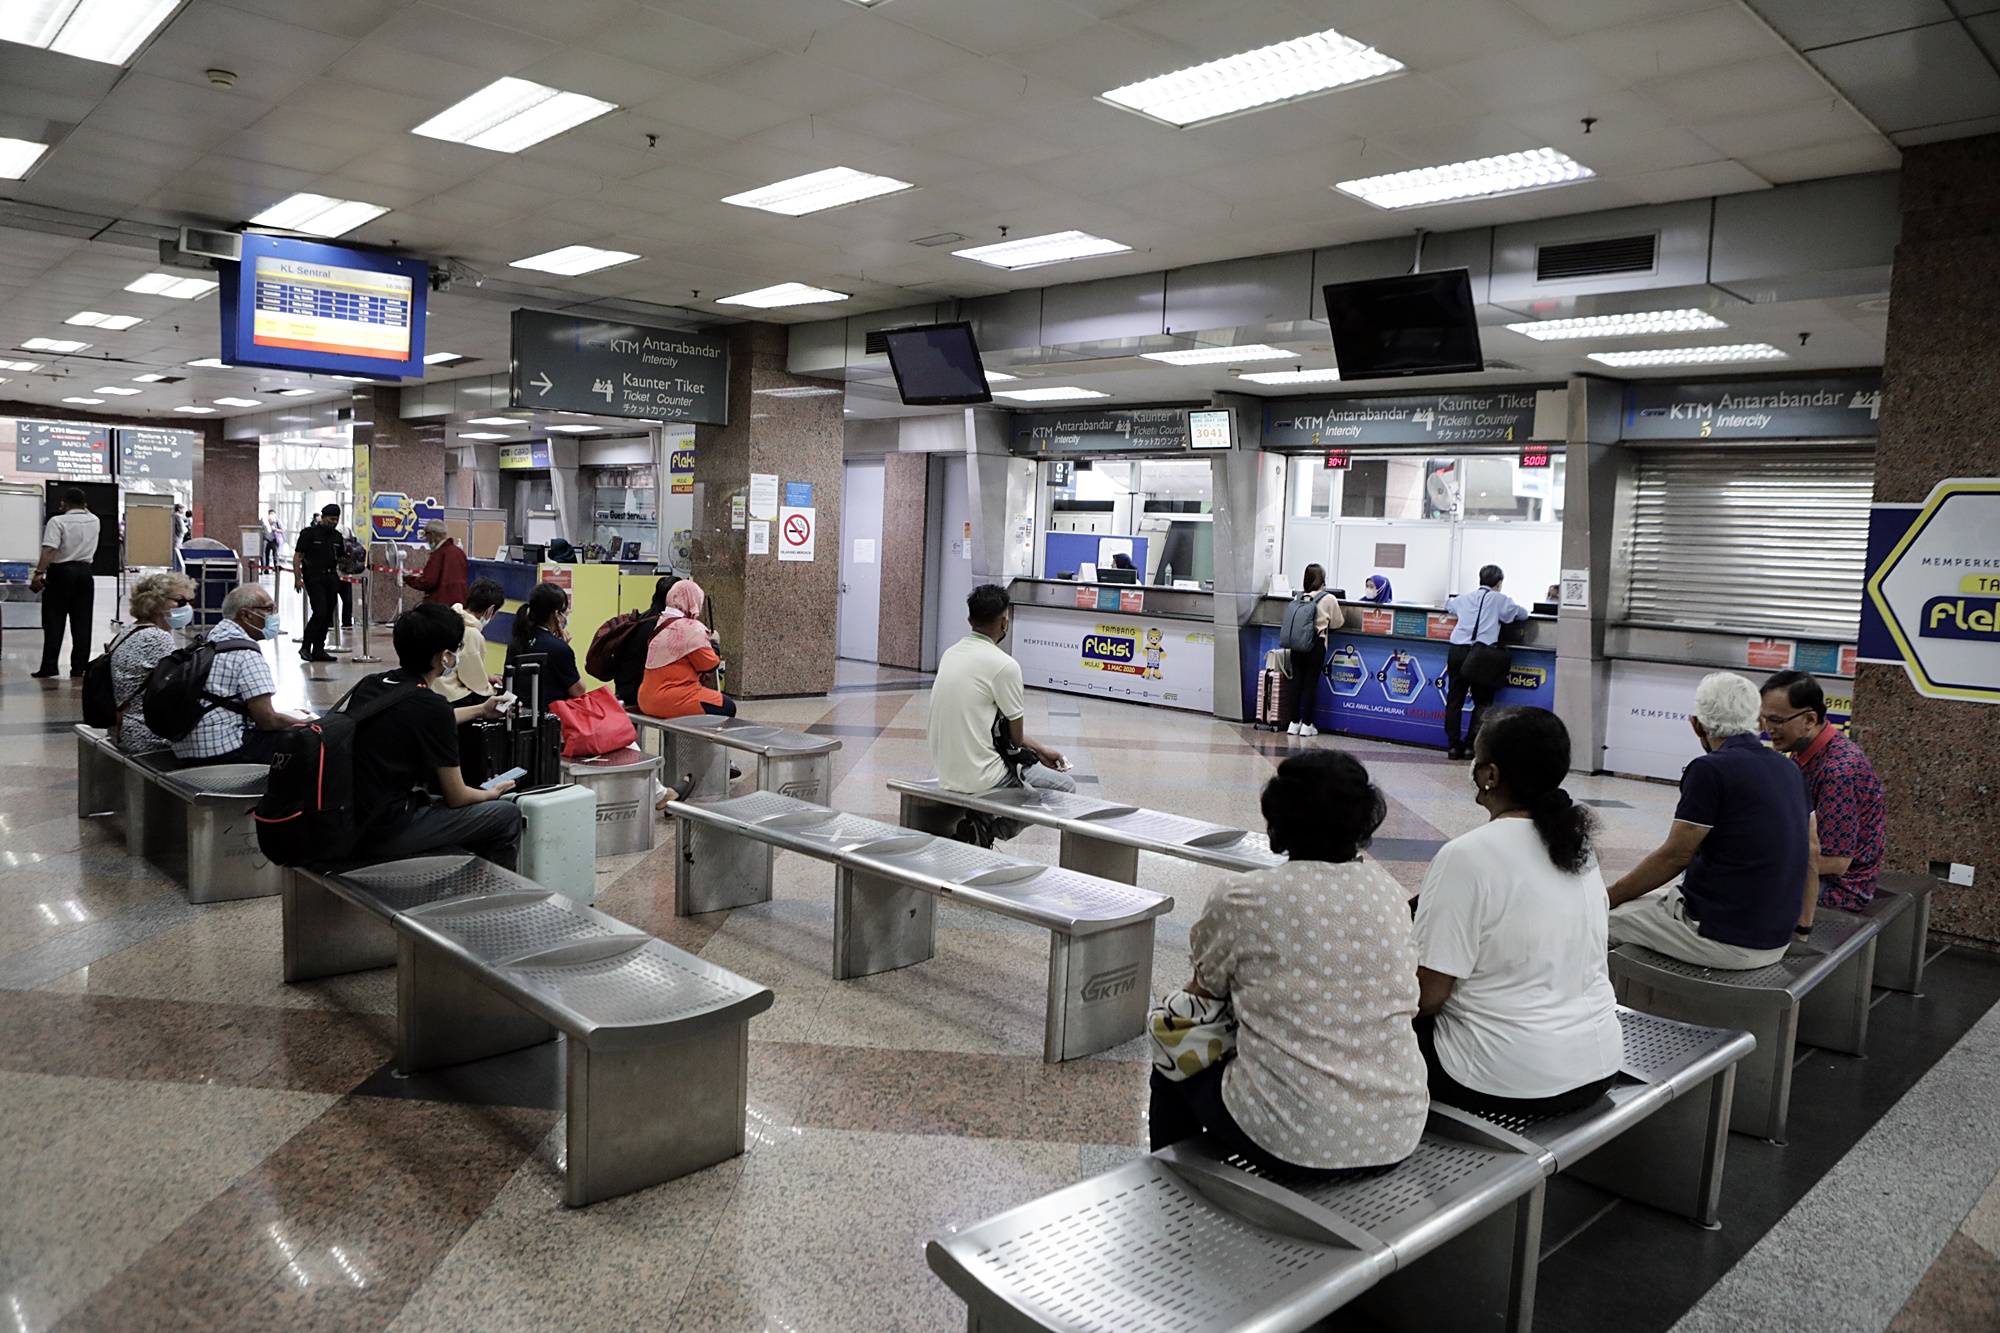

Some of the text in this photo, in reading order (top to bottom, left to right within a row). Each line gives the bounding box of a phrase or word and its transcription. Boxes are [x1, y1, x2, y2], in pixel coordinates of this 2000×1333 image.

[281, 264, 331, 278] KL Sentral
[610, 336, 721, 358] KTM Antarabandar
[642, 353, 678, 368] Intercity
[622, 373, 705, 394] Kaunter Tiket
[622, 390, 693, 407] Ticket Counter
[1438, 394, 1535, 411] Kaunter Tiket
[1670, 389, 1845, 420] KTM Antarabandar
[622, 403, 689, 417] チケットカウンター
[1133, 411, 1171, 422] Kaunter
[1294, 407, 1409, 430] KTM Antarabandar
[1475, 414, 1519, 426] Counter
[1716, 414, 1772, 430] Intercity
[1033, 420, 1114, 439] KTM Antarabandar
[1196, 428, 1223, 438] 3041
[1326, 426, 1362, 438] Intercity
[1700, 420, 1712, 438] 5
[1054, 435, 1080, 445] Intercity
[1327, 457, 1347, 467] 3041
[1523, 455, 1547, 466] 5008
[1101, 625, 1136, 636] TAMBANG
[1023, 638, 1079, 650] MEMPERKENALKAN
[1084, 661, 1100, 669] MULAI
[1111, 664, 1123, 672] MAC
[1379, 672, 1385, 680] 2
[1437, 679, 1443, 687] 3
[1406, 708, 1427, 718] LAGI
[271, 752, 292, 770] CR7
[603, 810, 637, 821] KTM
[1099, 976, 1136, 1000] KTM
